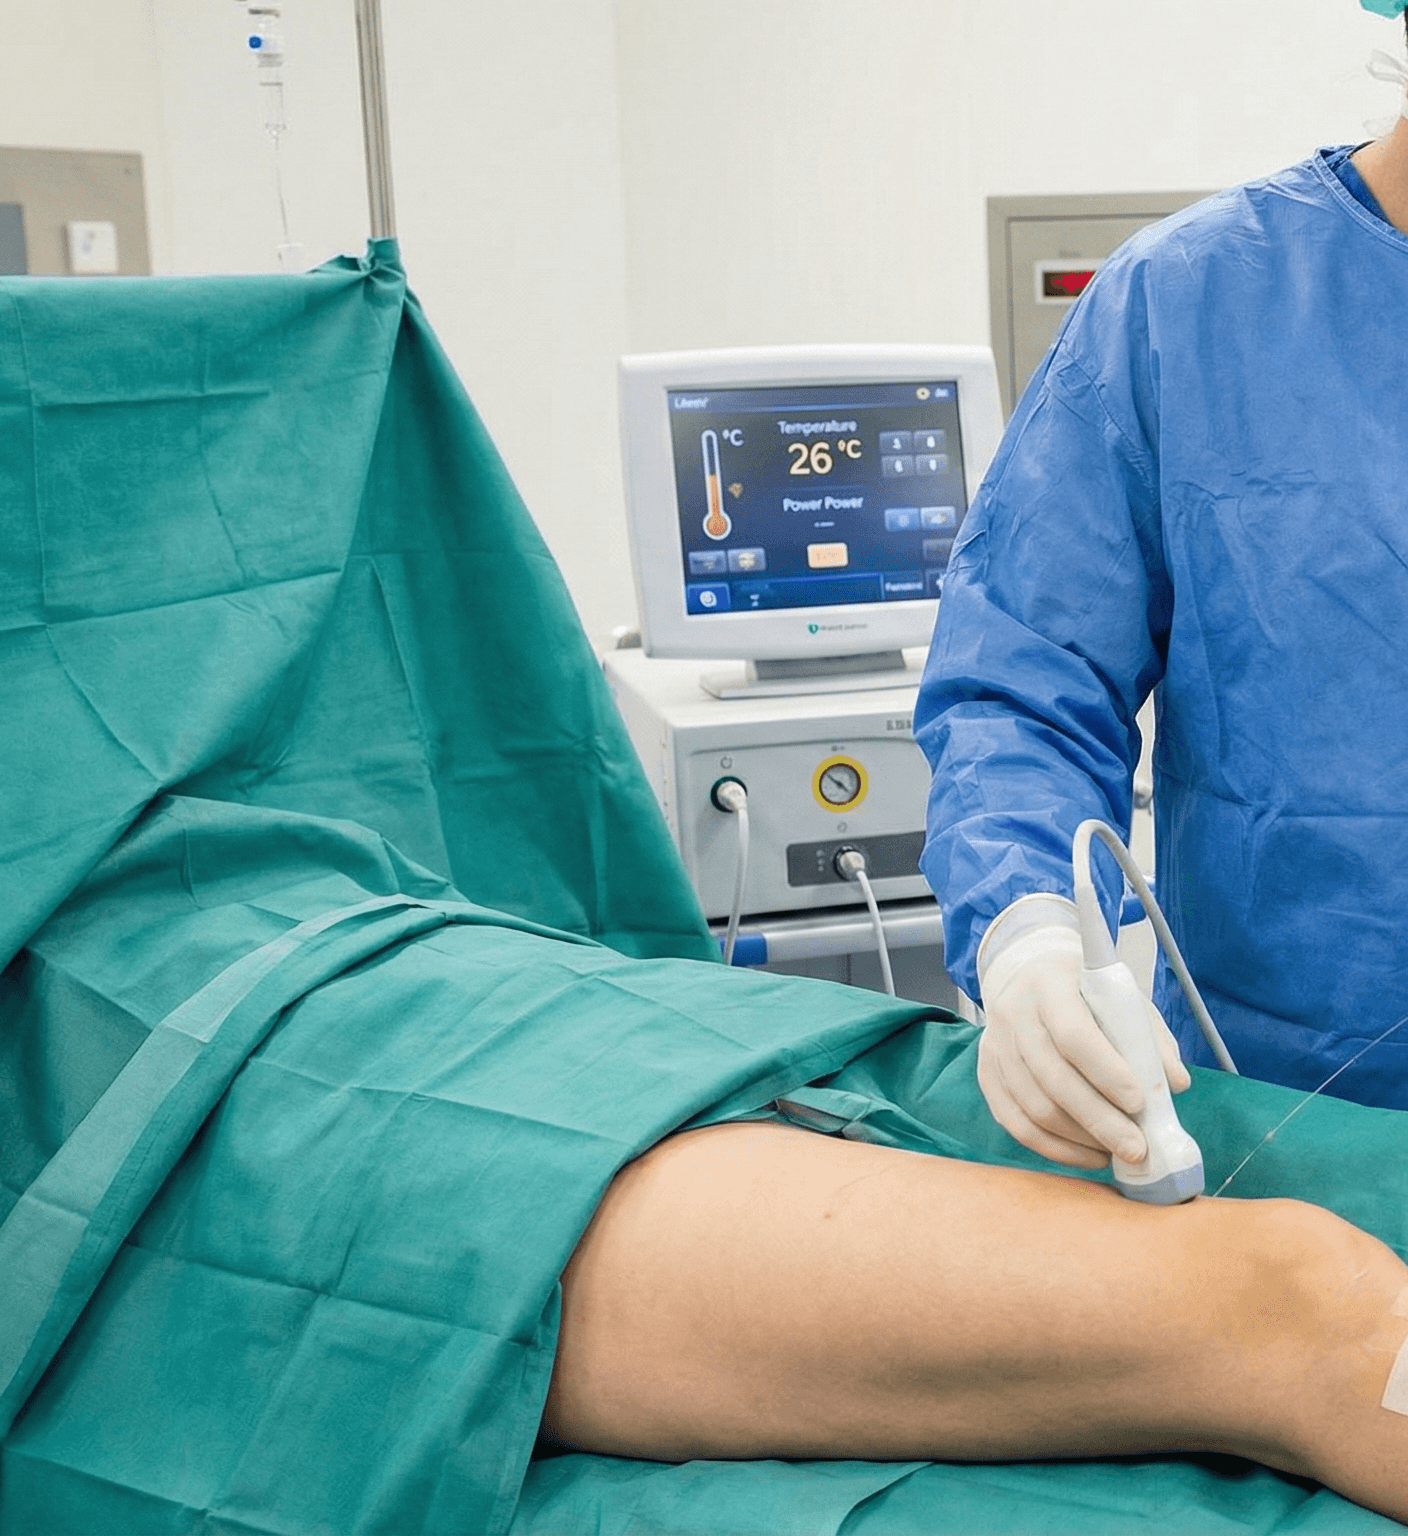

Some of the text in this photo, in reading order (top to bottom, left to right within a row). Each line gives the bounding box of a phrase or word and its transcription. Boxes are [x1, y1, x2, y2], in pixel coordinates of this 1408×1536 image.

[777, 420, 857, 437] Temperature
[788, 441, 833, 475] 26
[782, 495, 864, 512] Power Power
